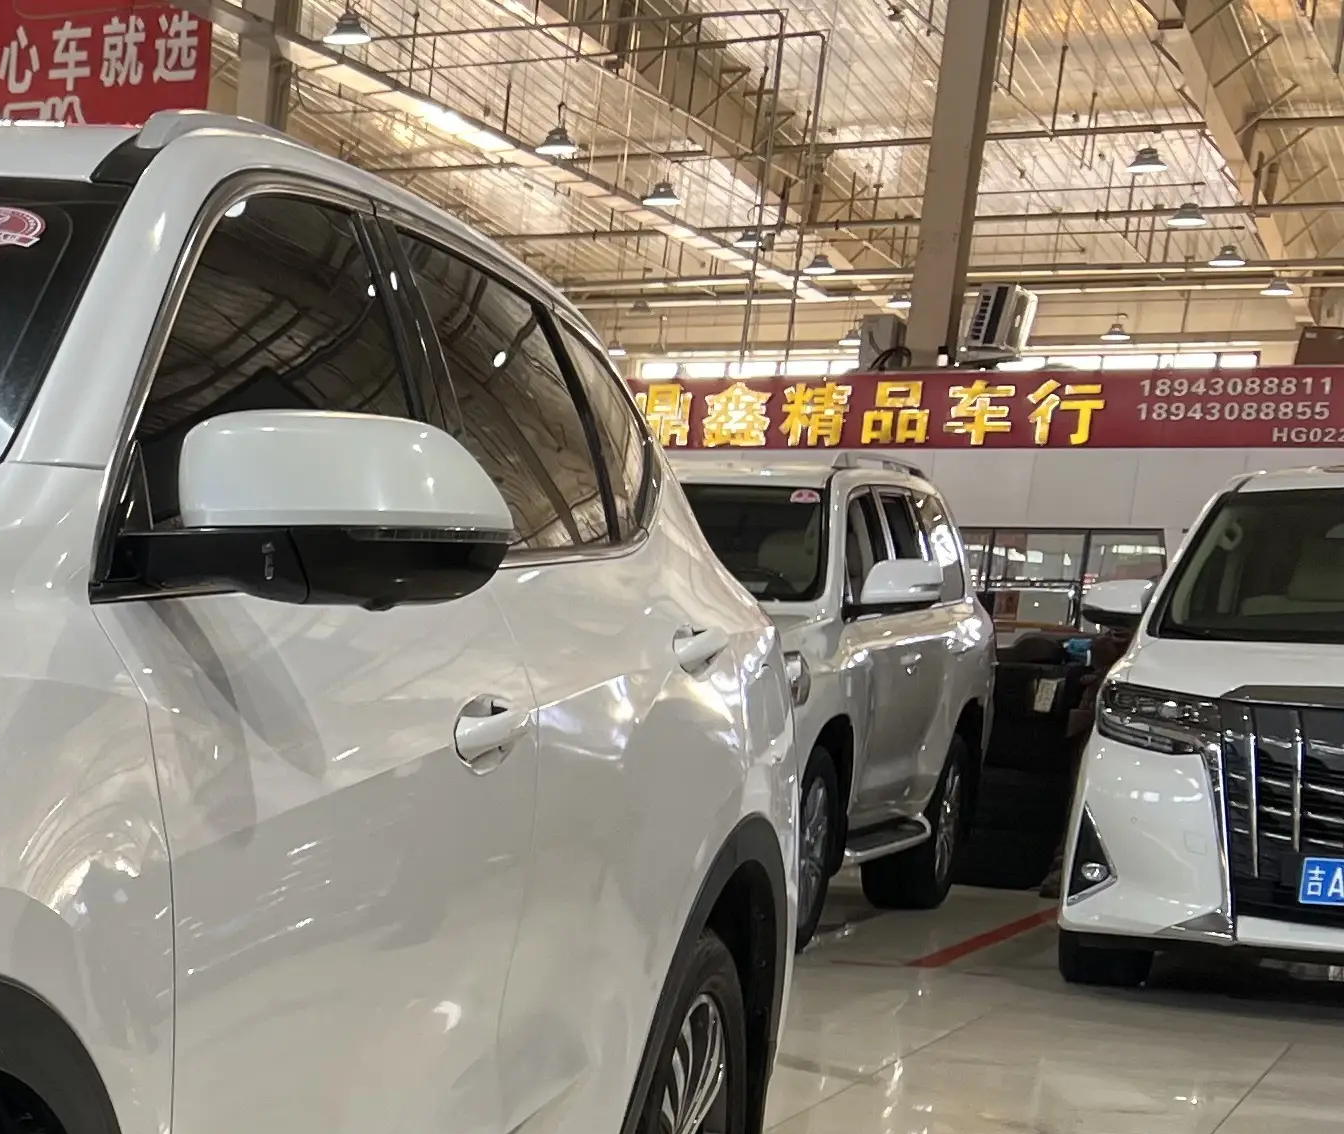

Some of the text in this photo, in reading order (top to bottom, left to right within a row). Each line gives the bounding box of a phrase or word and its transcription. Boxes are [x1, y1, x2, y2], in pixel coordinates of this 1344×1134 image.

[1139, 376, 1333, 397] 18943088811
[637, 379, 1106, 447] 鼎鑫精品车行
[1136, 401, 1330, 421] 18943088855
